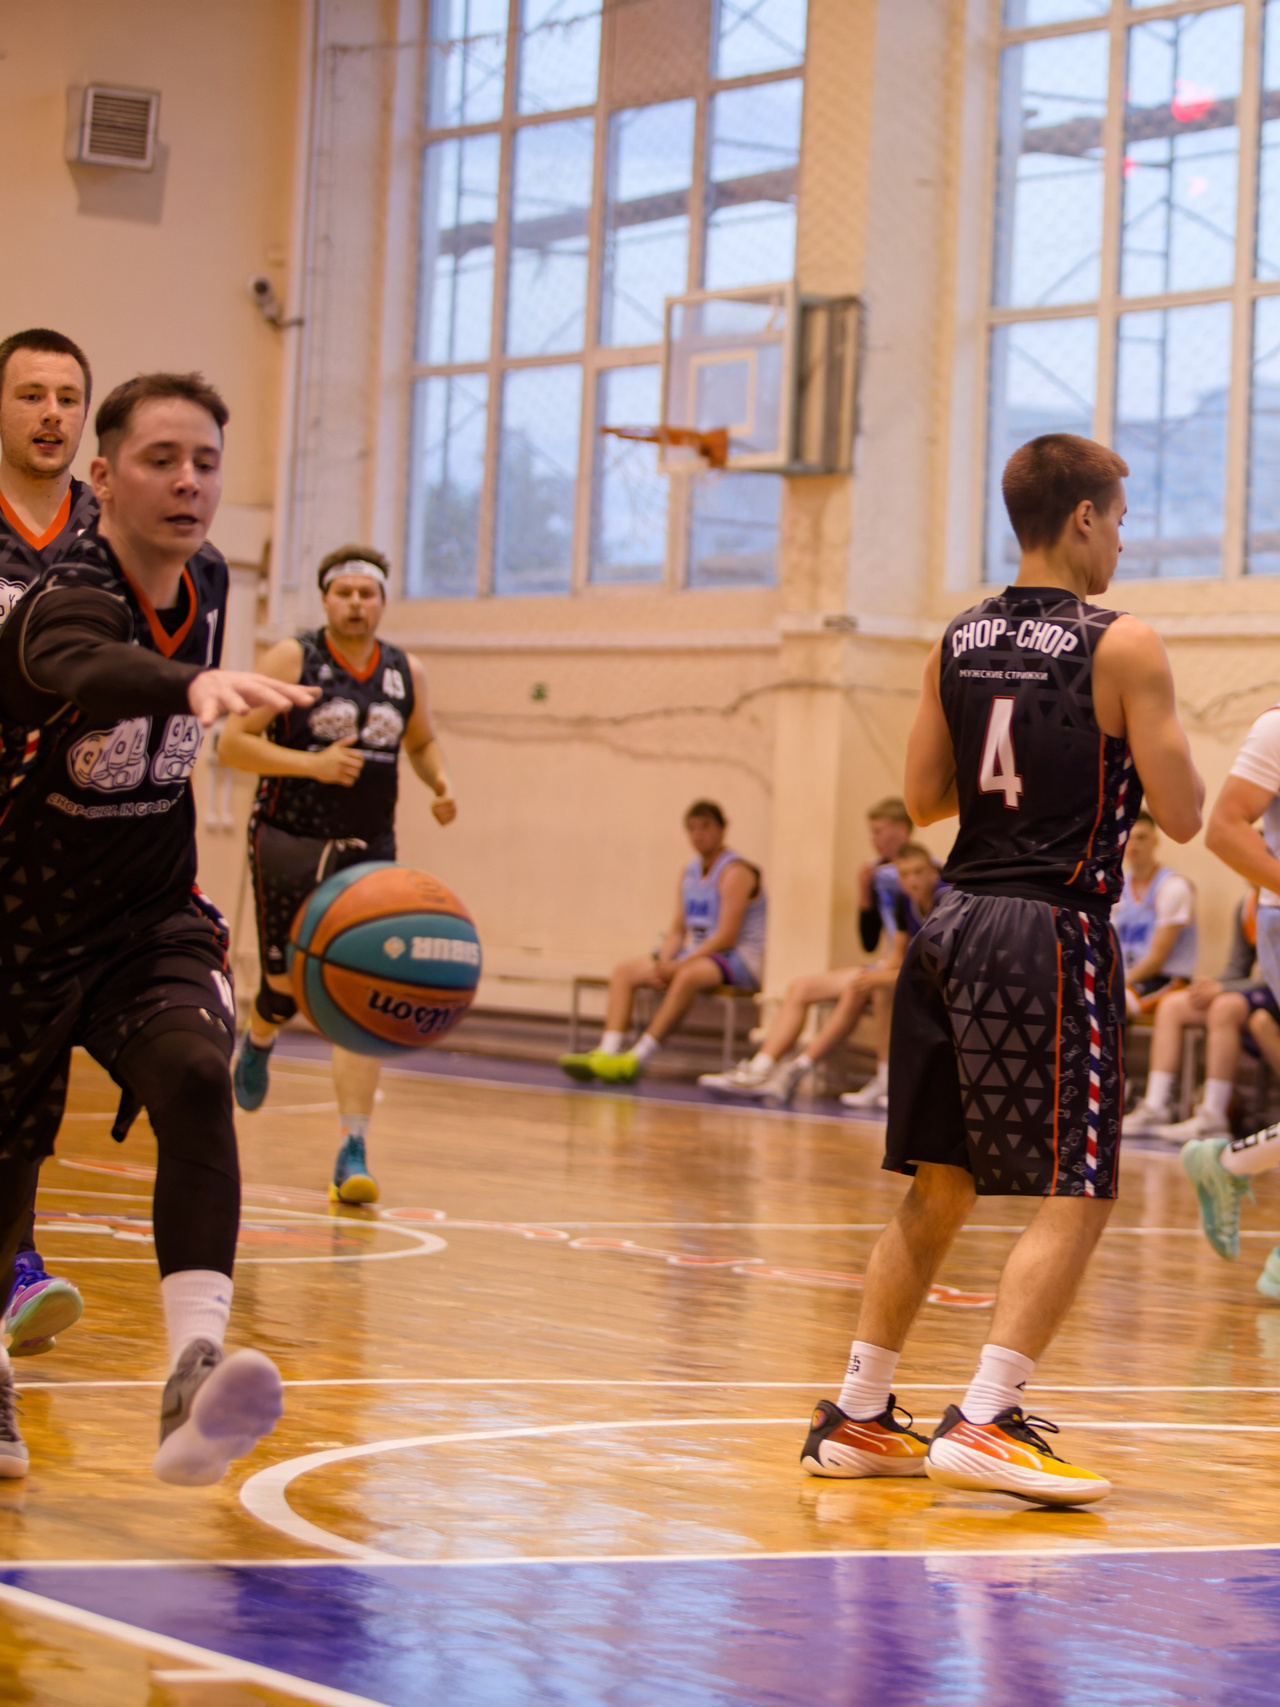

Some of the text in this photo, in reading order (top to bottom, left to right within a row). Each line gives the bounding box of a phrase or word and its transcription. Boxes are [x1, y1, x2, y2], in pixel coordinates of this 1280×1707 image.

[952, 618, 1079, 659] CHOP-CHOP
[959, 669, 1049, 681] МУЖСКИЕ СТРИЖКИ
[977, 695, 1024, 810] 4
[367, 989, 469, 1035] ilson
